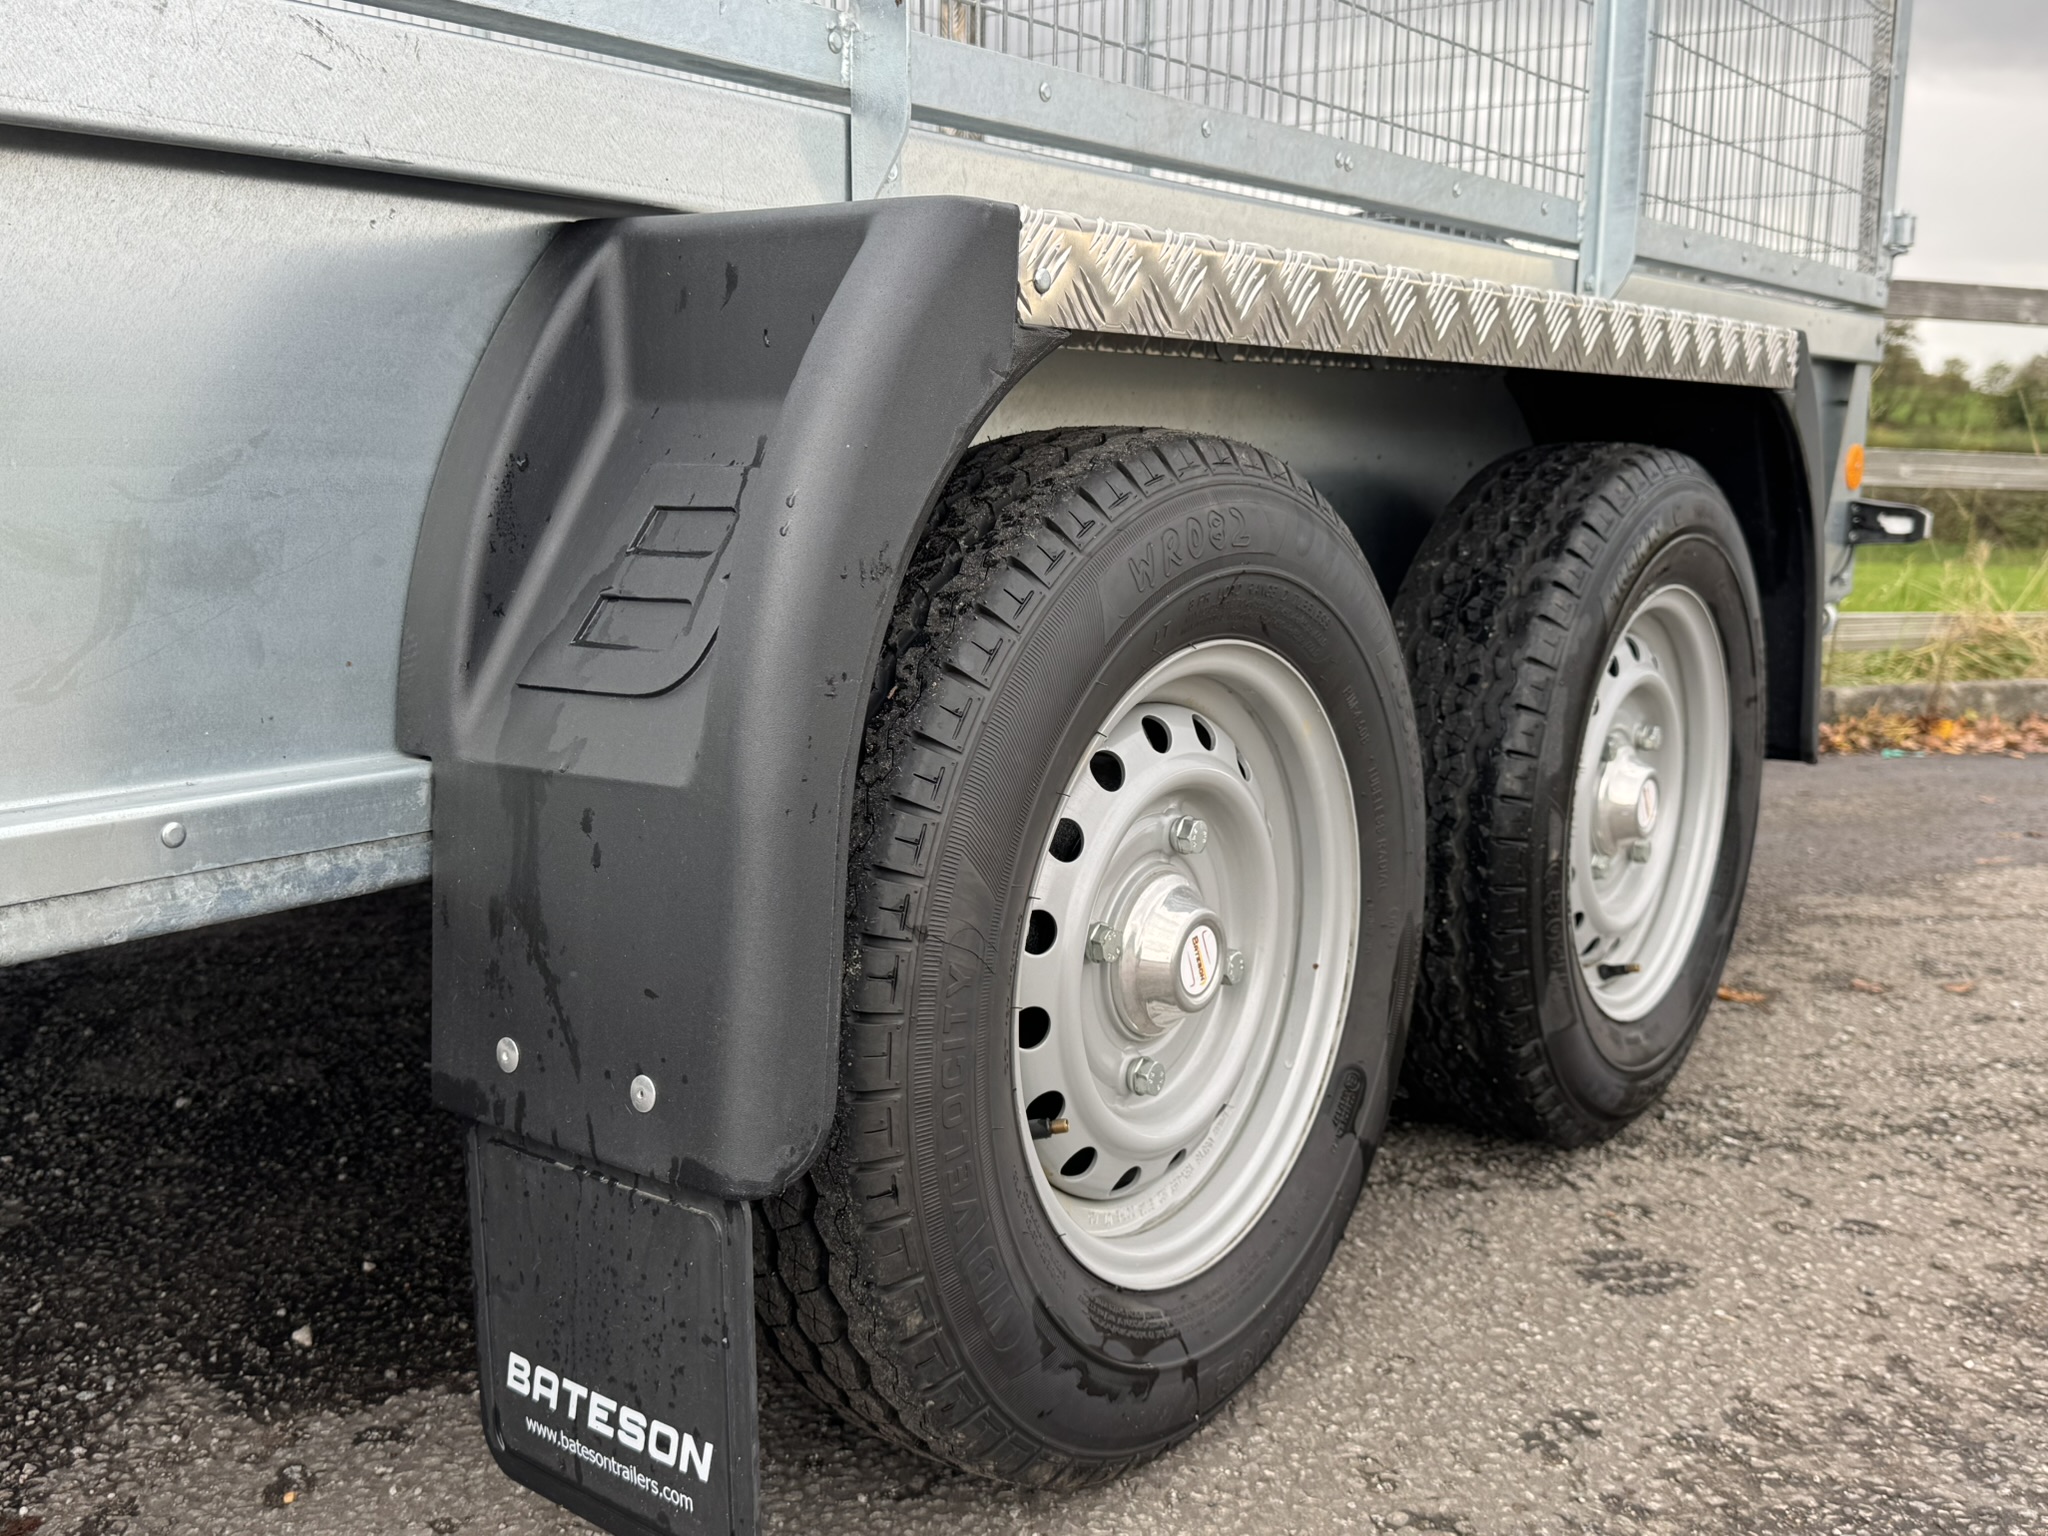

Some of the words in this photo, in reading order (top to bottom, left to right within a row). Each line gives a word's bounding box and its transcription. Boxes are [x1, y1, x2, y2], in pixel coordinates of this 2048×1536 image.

[1128, 506, 1251, 593] WR082
[940, 960, 982, 1235] VELOCITY
[507, 1351, 714, 1483] BATESON
[525, 1414, 695, 1513] www.batesontrailers.com
